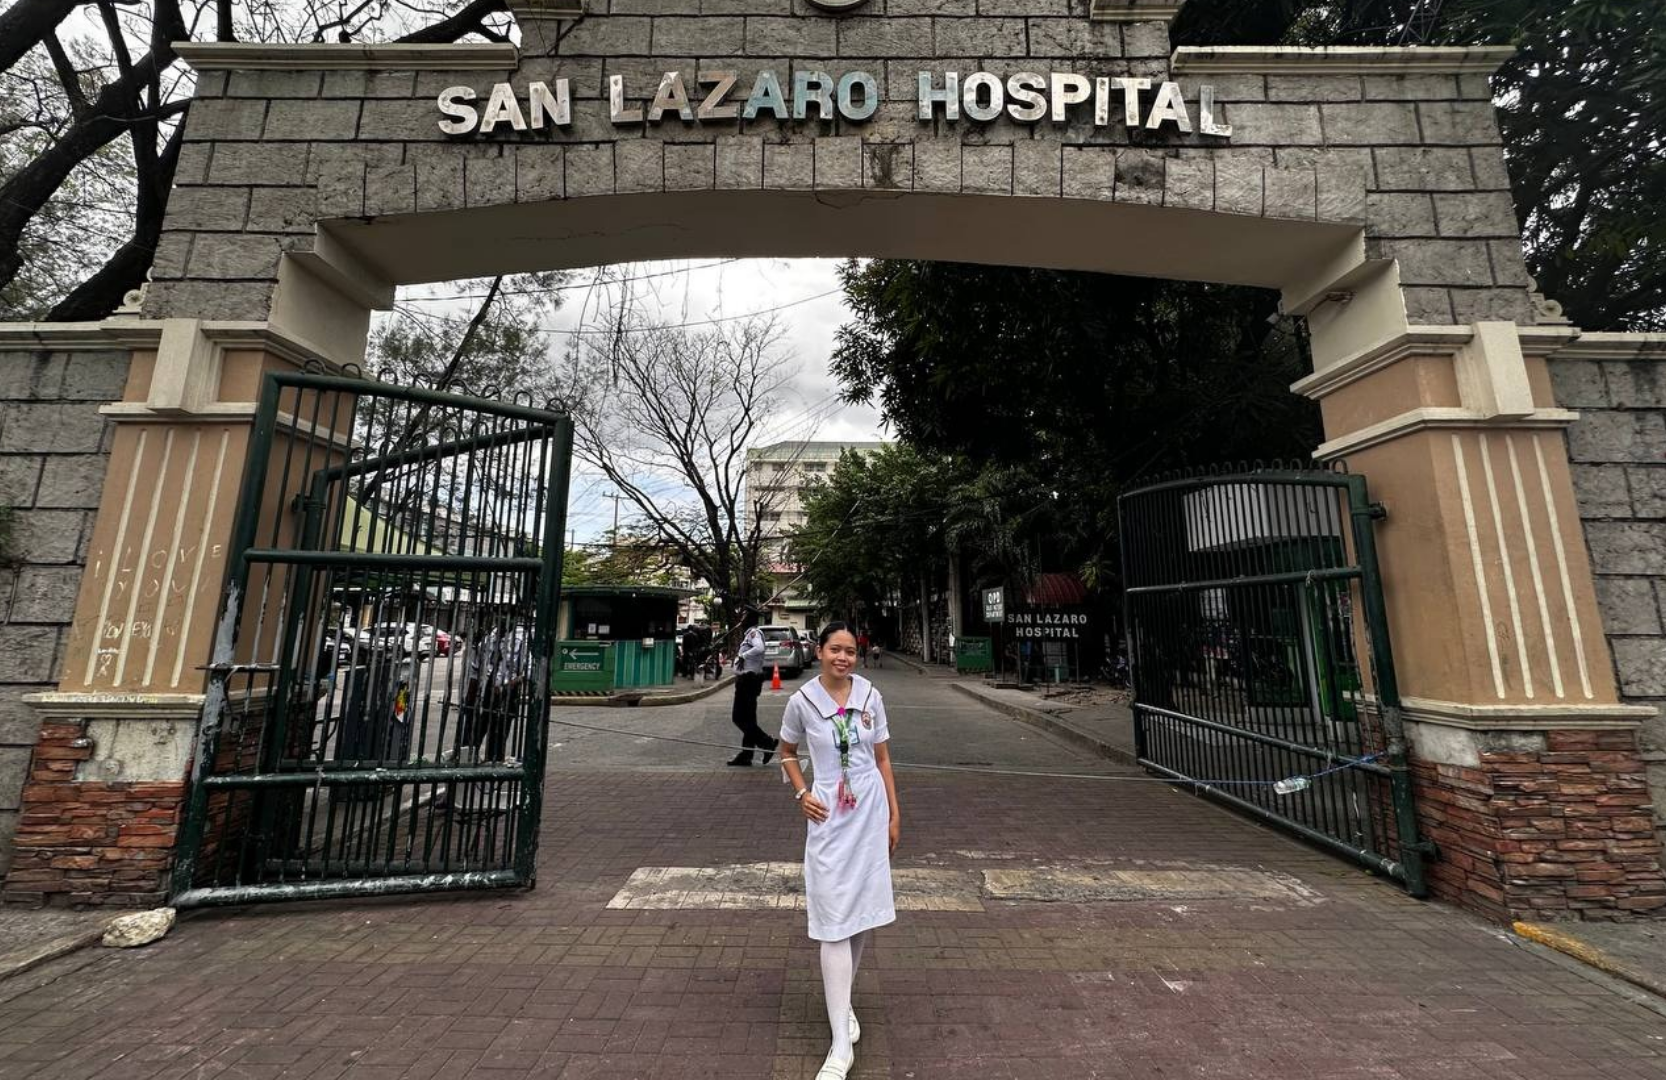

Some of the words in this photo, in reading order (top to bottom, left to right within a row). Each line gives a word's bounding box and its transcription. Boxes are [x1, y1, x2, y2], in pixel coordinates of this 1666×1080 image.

[437, 79, 571, 135] SAN
[609, 70, 878, 123] LAZARO
[918, 71, 1232, 137] HOSPITAL
[1007, 613, 1032, 623] SAN
[1036, 613, 1087, 624] LAZARO
[1015, 627, 1079, 637] HOSPITAL
[563, 662, 601, 670] EMERGENCY
